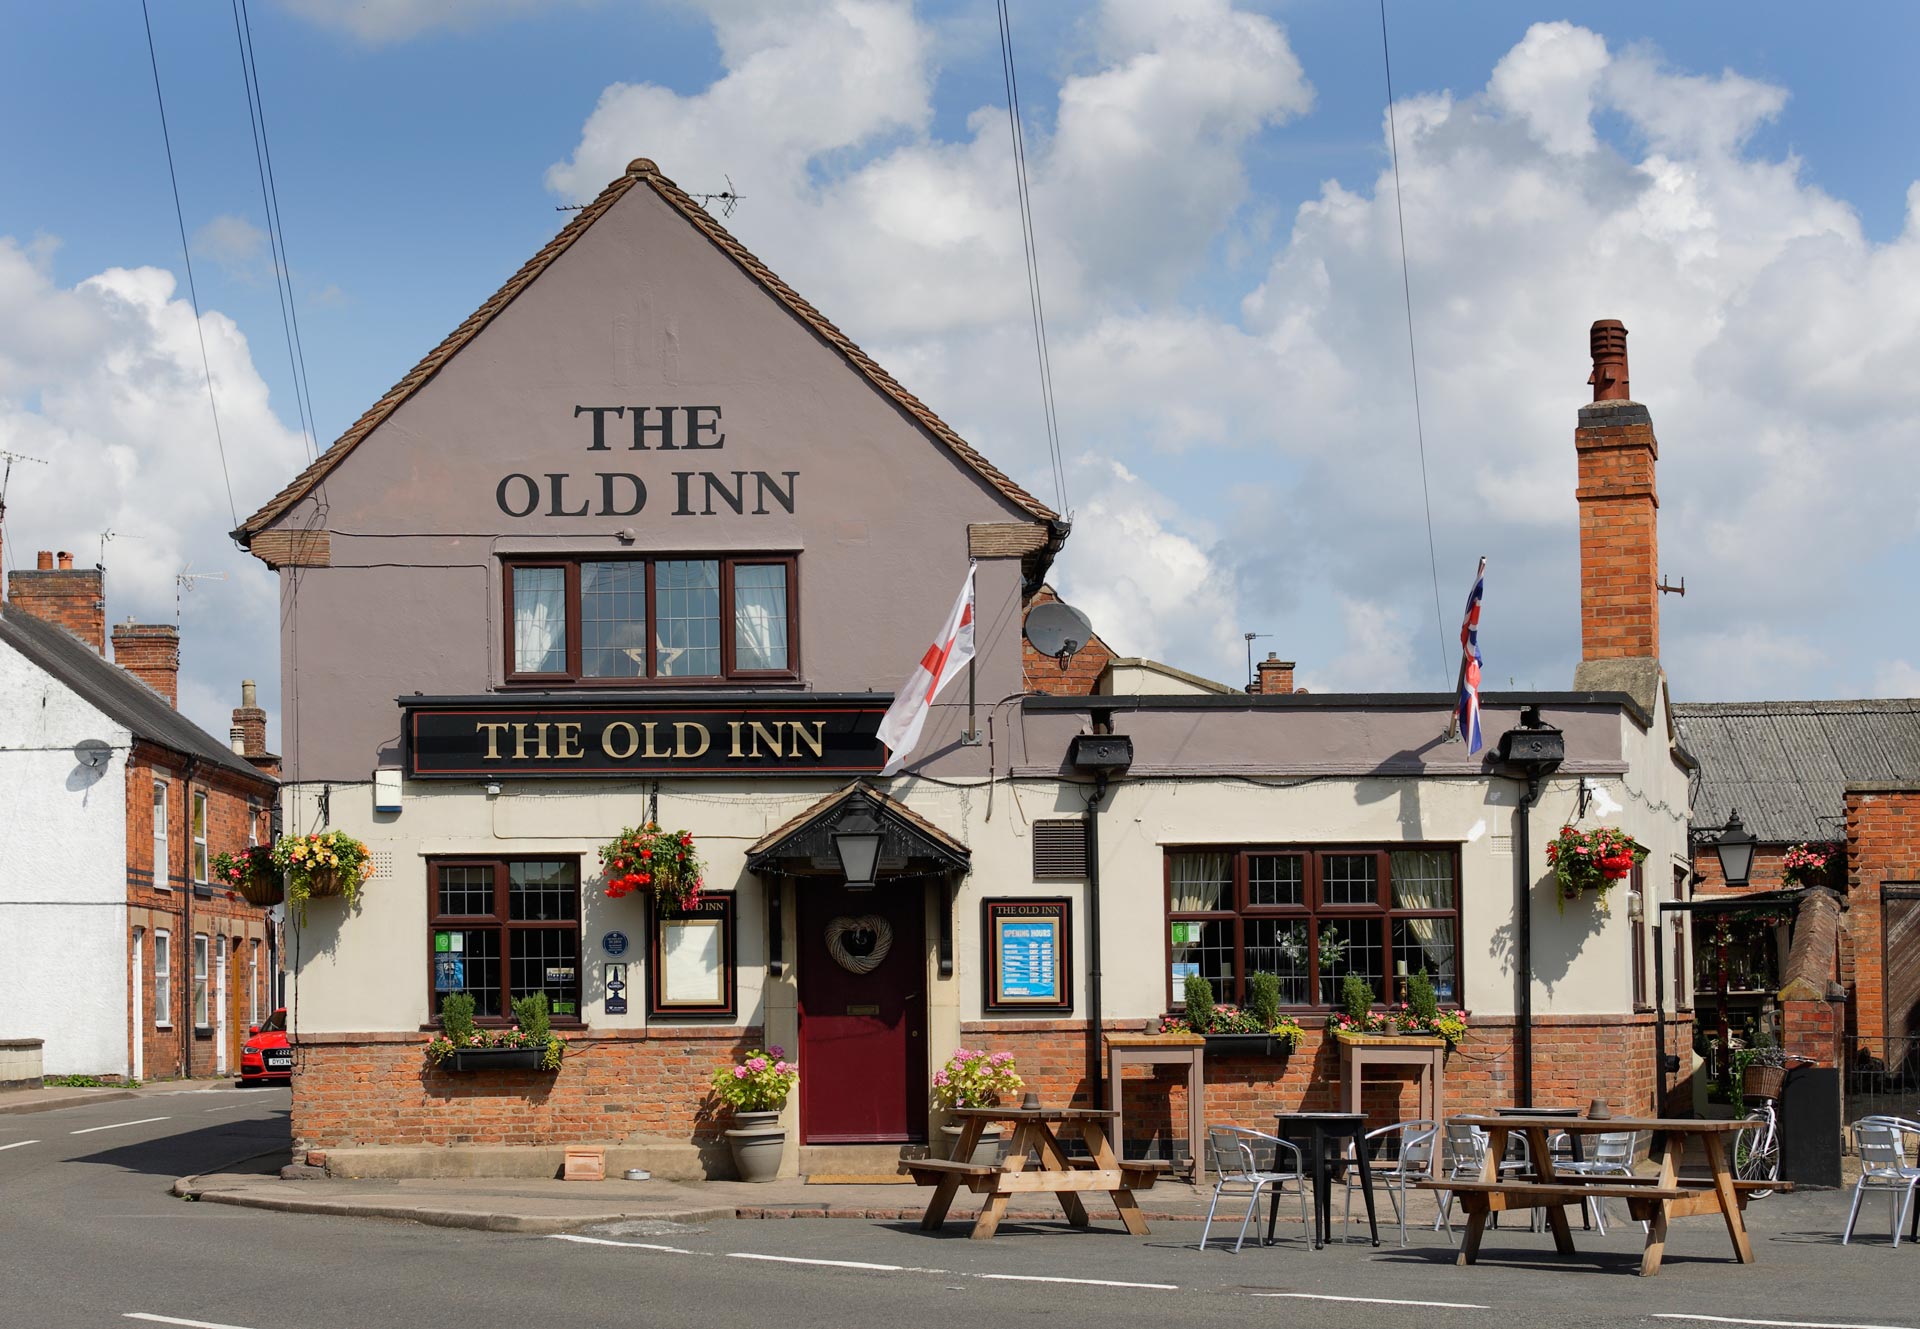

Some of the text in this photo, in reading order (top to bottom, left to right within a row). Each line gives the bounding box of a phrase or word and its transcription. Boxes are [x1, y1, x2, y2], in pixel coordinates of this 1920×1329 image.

[574, 405, 726, 451] THE
[496, 471, 801, 518] OLD INN
[476, 720, 827, 760] THE OLD INN
[705, 902, 724, 911] INN
[996, 906, 1060, 914] THE OLD INN
